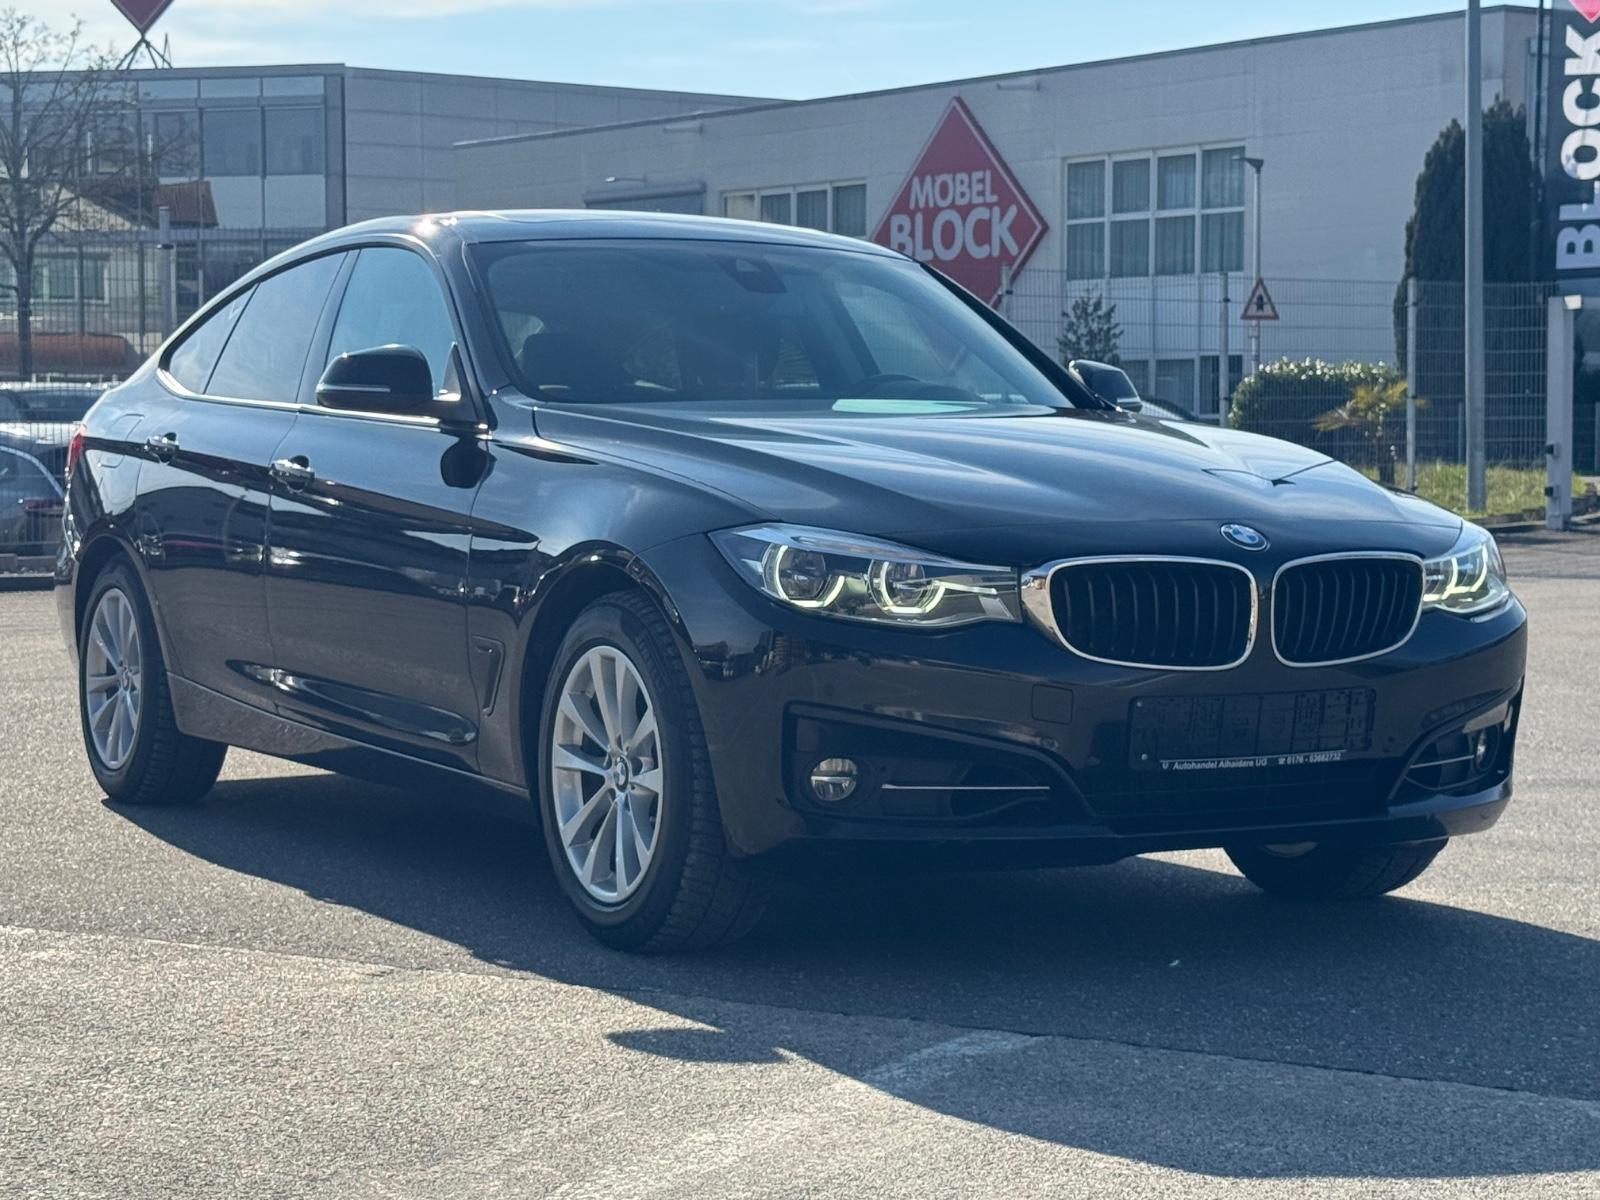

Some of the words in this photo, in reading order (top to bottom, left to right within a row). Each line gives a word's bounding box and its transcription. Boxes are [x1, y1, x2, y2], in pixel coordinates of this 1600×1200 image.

[1555, 24, 1600, 270] BLOCK
[889, 204, 1018, 261] BLOCK
[1172, 760, 1217, 770] Autohandel
